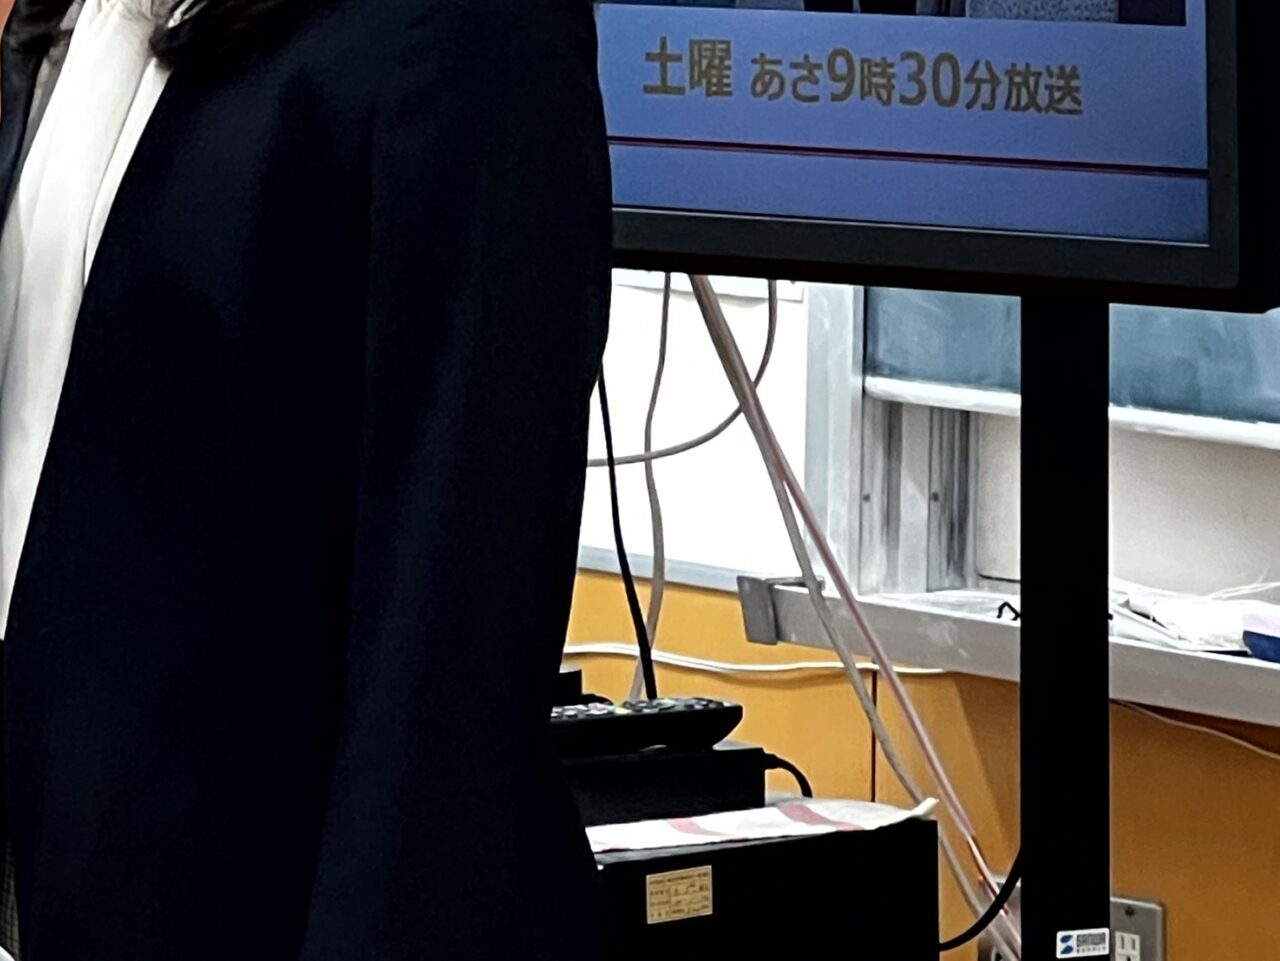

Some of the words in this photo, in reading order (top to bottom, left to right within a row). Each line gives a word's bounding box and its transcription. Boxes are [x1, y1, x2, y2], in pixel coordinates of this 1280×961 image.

[643, 36, 733, 98] 土曜
[750, 47, 1083, 115] あさ9時30分放送
